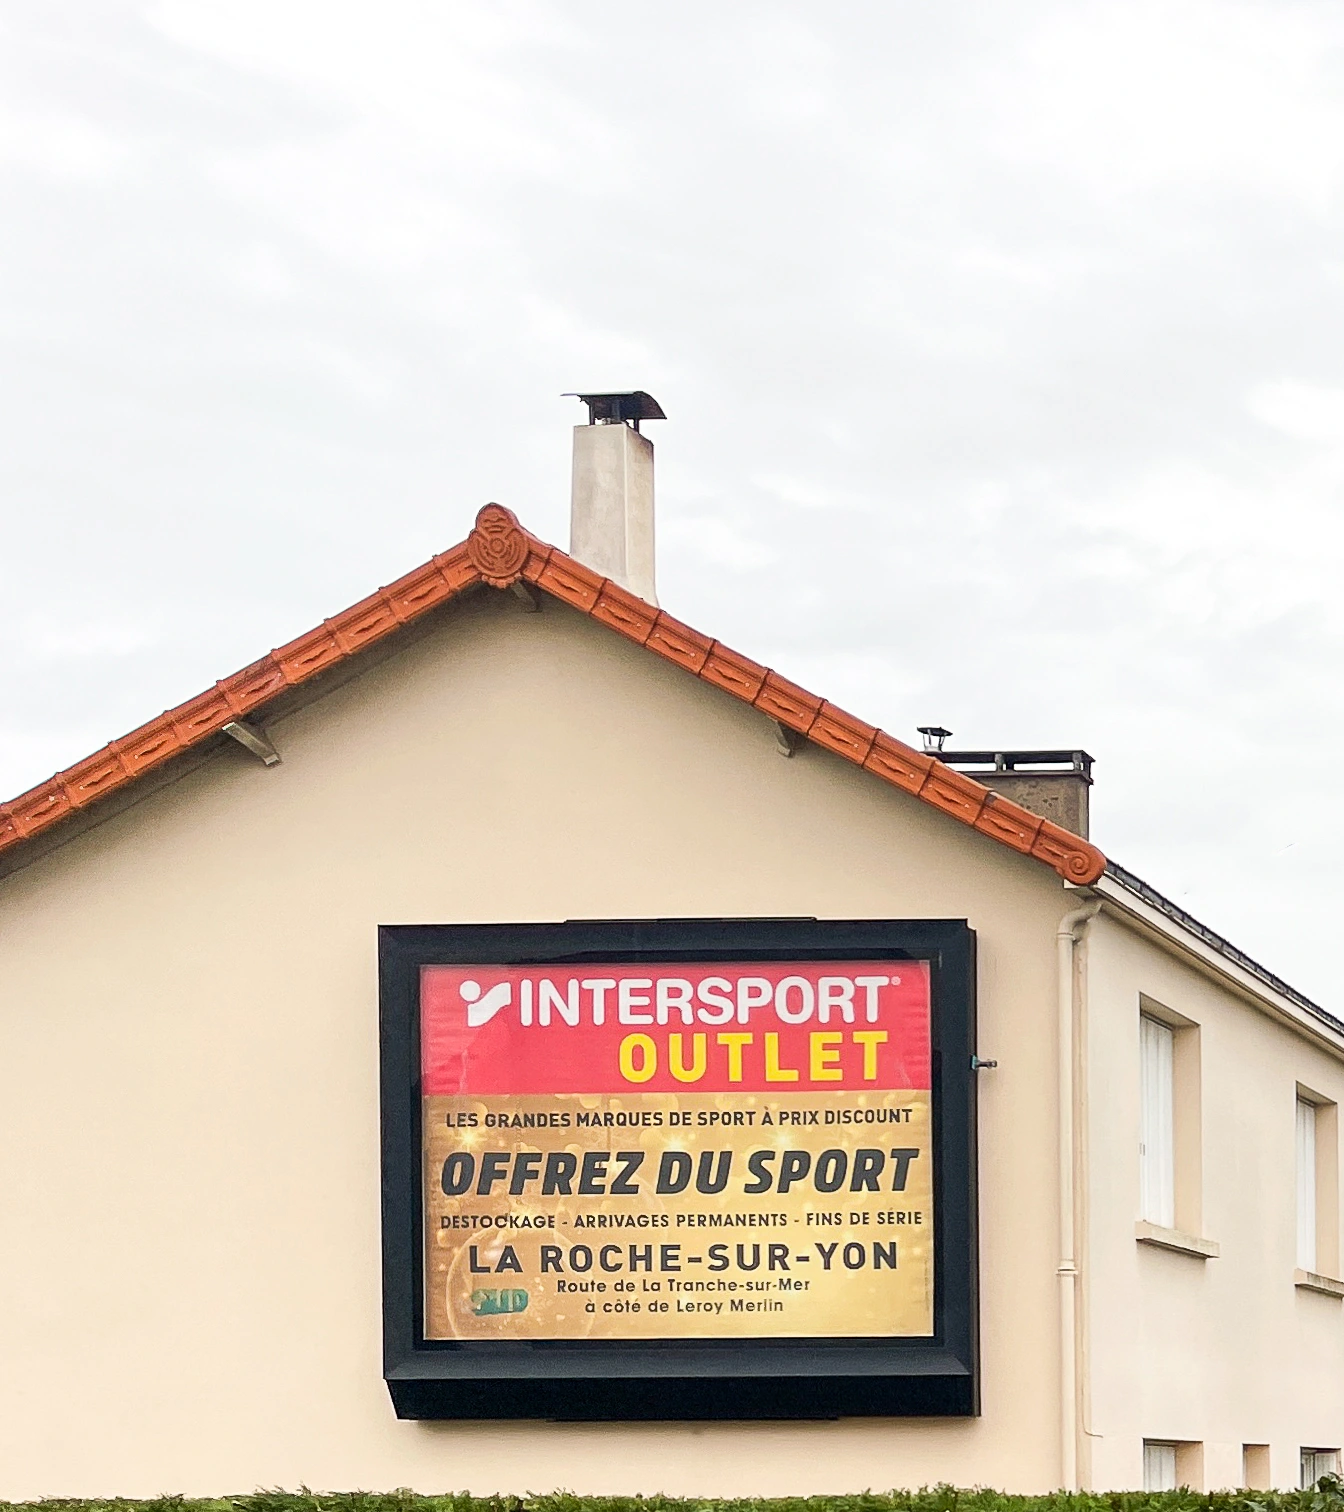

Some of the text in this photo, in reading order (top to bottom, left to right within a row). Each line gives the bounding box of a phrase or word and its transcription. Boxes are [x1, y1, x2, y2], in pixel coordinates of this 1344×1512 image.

[520, 976, 890, 1027] INTERSPORT
[619, 1031, 889, 1084] OUTLET
[446, 1106, 913, 1129] LES GRANDES MARQUES DE SPORT À PRIX DISCOUNT
[440, 1148, 920, 1196] OFFREZ DU SPORT
[440, 1213, 555, 1230] DESTOCKAGE
[573, 1214, 669, 1229] ARRIVAGES
[676, 1213, 787, 1228] PERMANENTS
[806, 1212, 843, 1226] FINS
[849, 1211, 870, 1225] DE
[877, 1207, 923, 1225] SÉRIE
[469, 1241, 898, 1274] LA ROCHE-SUR-YON
[557, 1278, 811, 1293] Route de La Tranche-sur-Mer
[585, 1298, 785, 1315] à côté de Leroy Merlin
